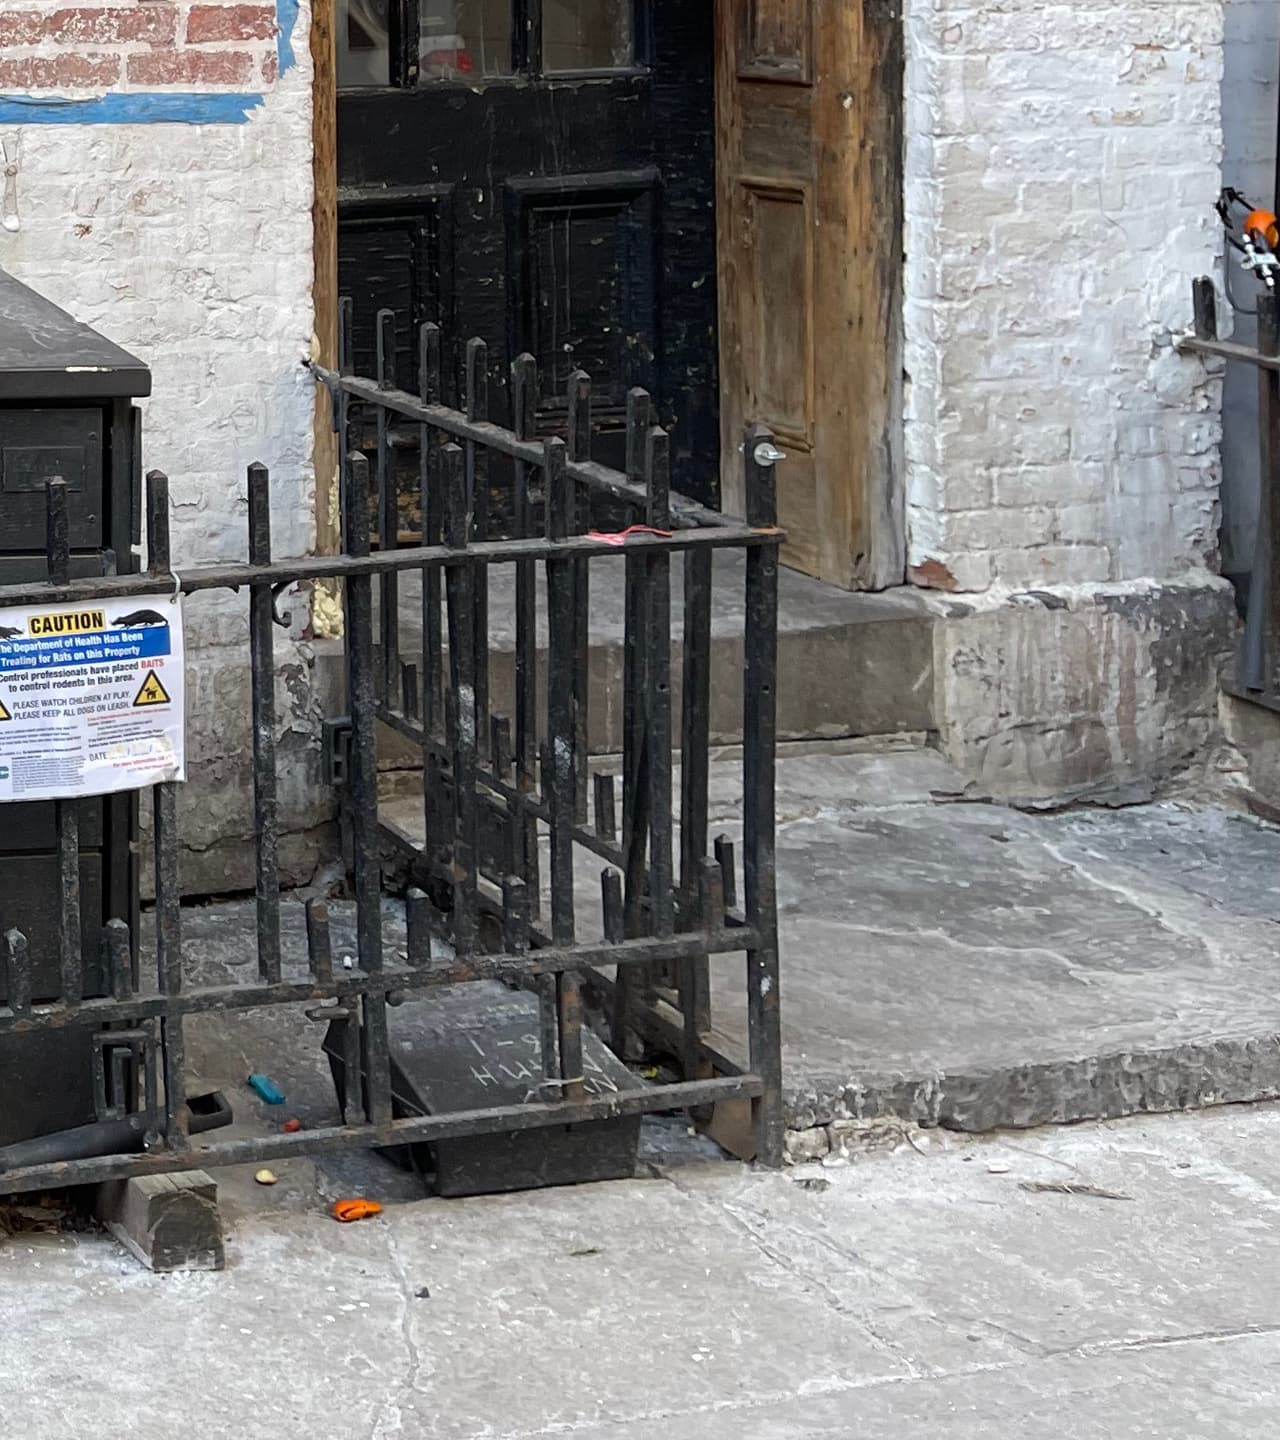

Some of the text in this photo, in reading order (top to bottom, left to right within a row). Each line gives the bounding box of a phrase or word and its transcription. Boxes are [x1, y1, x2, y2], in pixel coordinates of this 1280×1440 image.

[30, 612, 104, 634] CAUTION
[14, 640, 63, 653] Department
[64, 638, 73, 648] of
[75, 635, 102, 647] Health
[103, 634, 120, 644] Has
[121, 632, 144, 642] Been
[1, 646, 140, 667] Treating for Rats on this Property
[31, 666, 88, 681] professionals
[90, 665, 110, 674] have
[112, 662, 139, 673] placed
[141, 658, 164, 669] BAITS
[9, 673, 135, 693] to control rodents in this area.
[13, 700, 39, 710] PLEASE
[41, 698, 67, 707] WATCH
[69, 695, 101, 705] CHILDREN
[103, 692, 112, 701] AT
[14, 701, 131, 721] PLEASE KEEP ALL DOGS ON LEASH.
[89, 752, 107, 762] DATE
